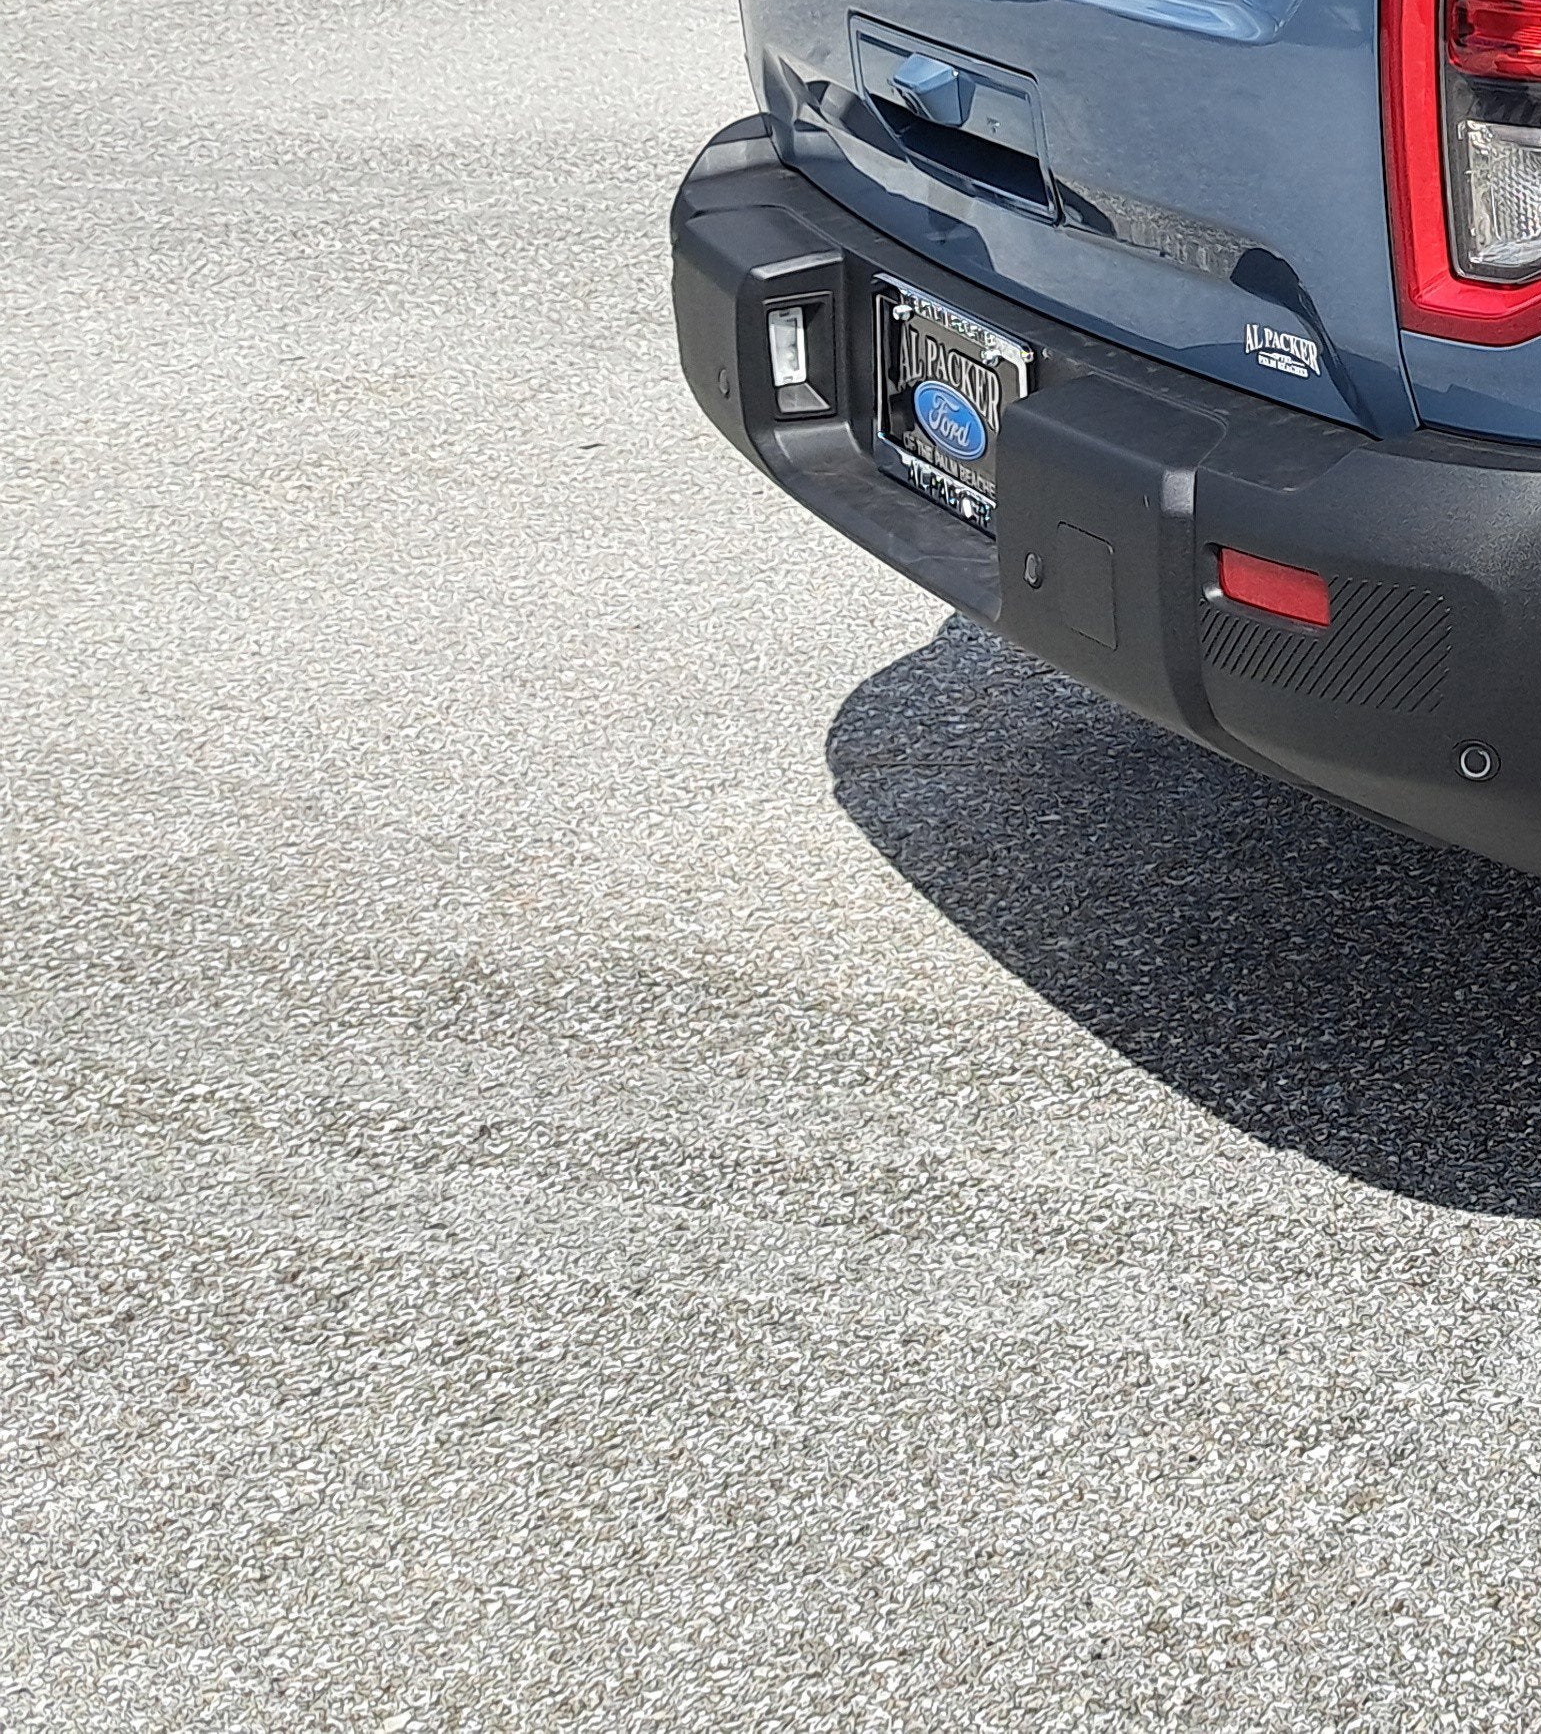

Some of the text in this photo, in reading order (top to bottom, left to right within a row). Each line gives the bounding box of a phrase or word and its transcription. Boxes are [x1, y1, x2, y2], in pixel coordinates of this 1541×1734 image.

[1245, 323, 1321, 376] AL PACKER
[899, 323, 1000, 436] AL PACKER
[927, 393, 972, 448] Ford
